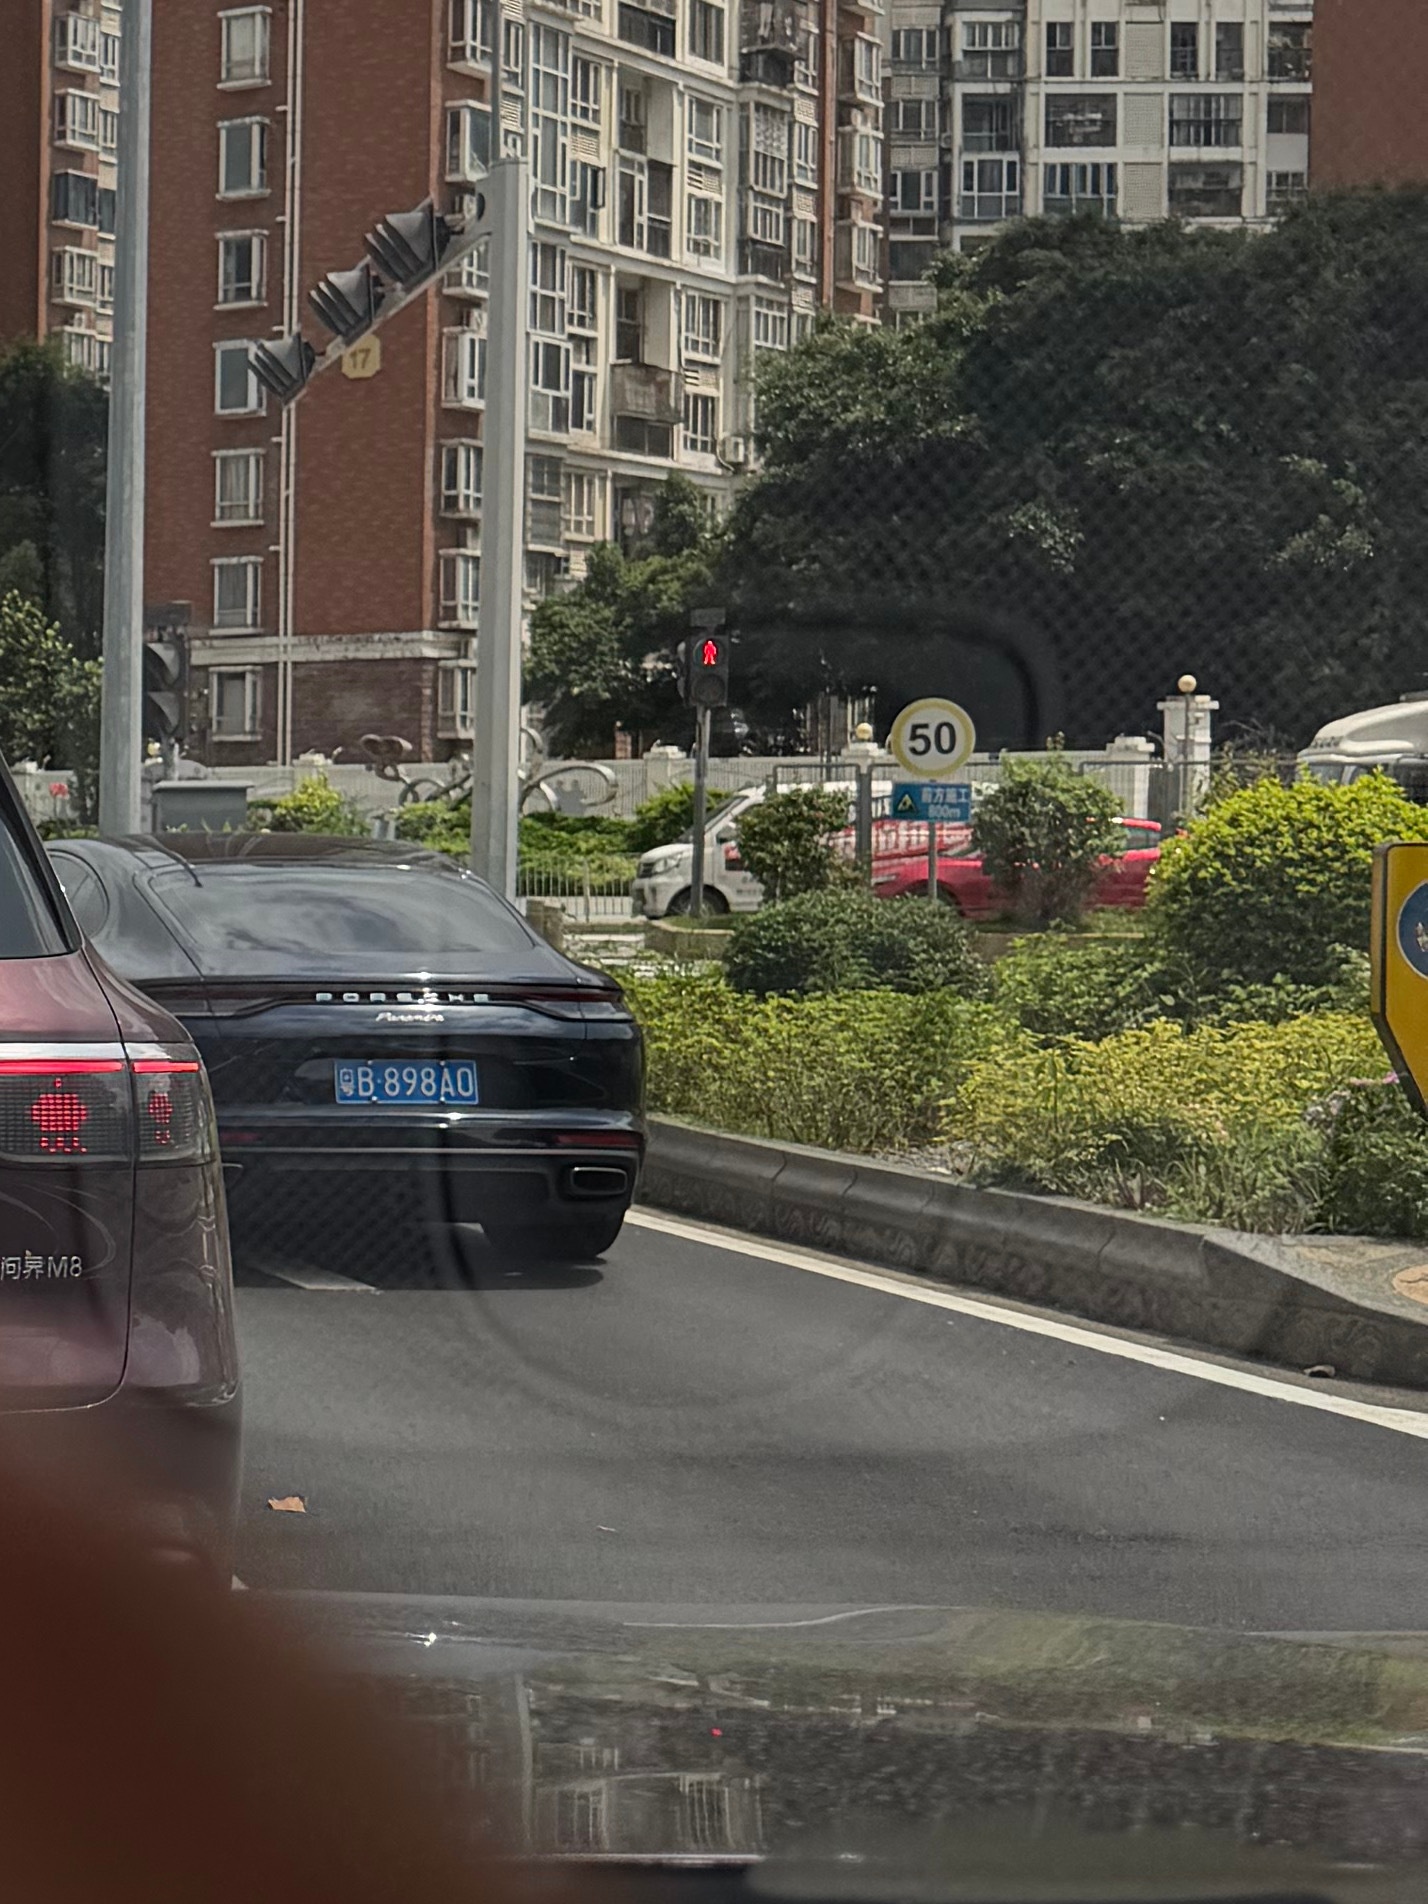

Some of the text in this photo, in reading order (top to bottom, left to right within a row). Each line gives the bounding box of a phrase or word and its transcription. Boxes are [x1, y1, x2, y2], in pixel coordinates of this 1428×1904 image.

[349, 348, 371, 369] 17
[909, 722, 956, 756] 50
[1, 1256, 83, 1280] 问界M8
